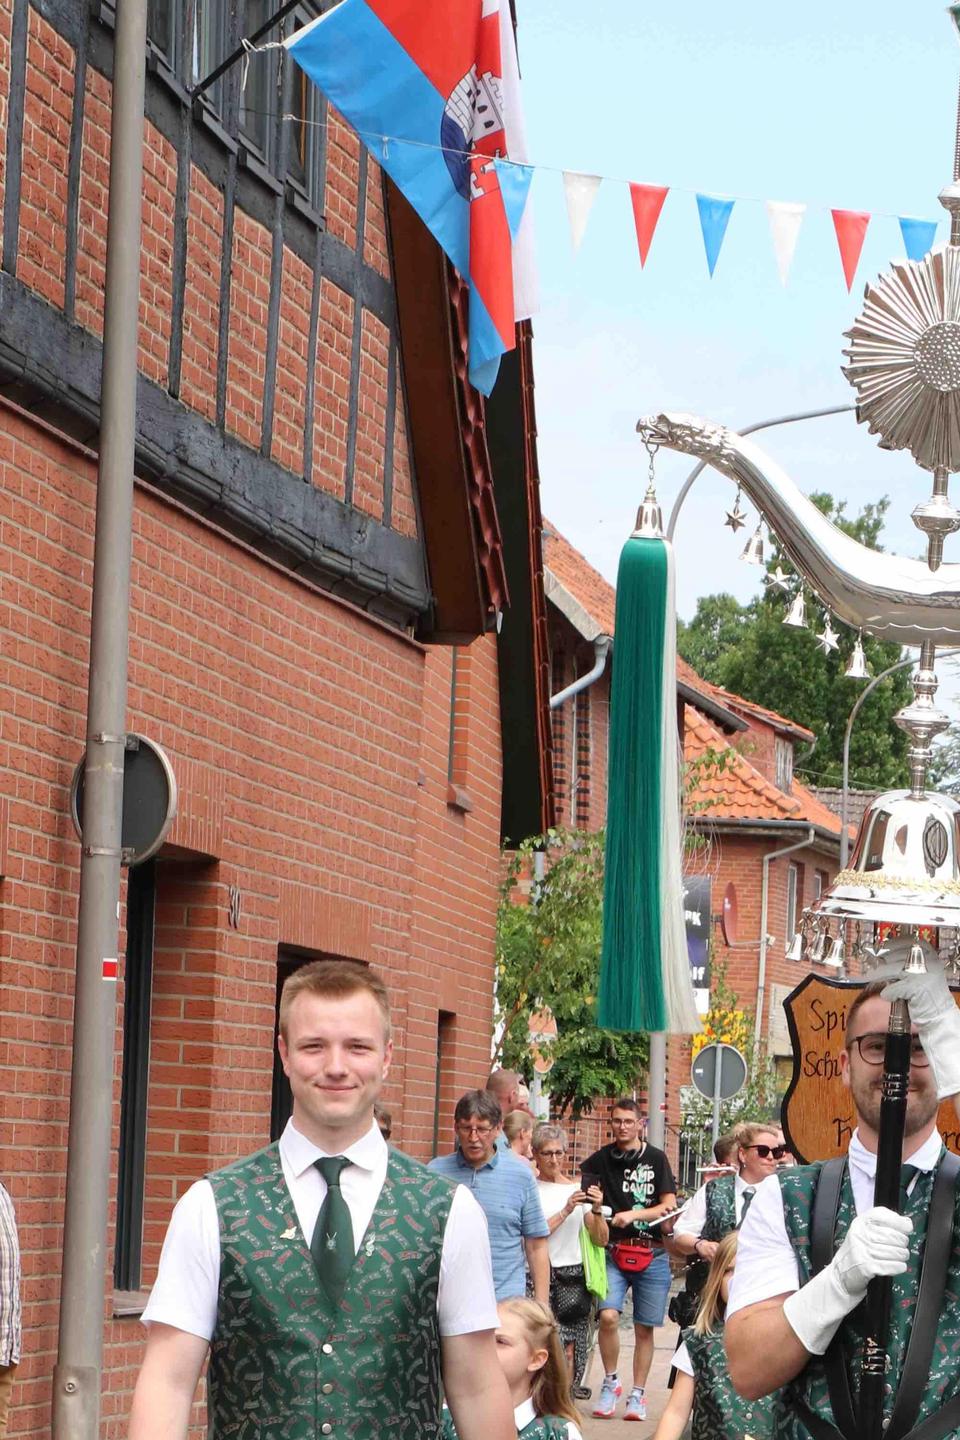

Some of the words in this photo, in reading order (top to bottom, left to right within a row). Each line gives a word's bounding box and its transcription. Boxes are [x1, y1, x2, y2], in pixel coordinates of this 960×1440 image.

[684, 910, 701, 926] RK
[624, 1168, 655, 1183] CAMP
[622, 1180, 655, 1196] DAVID
